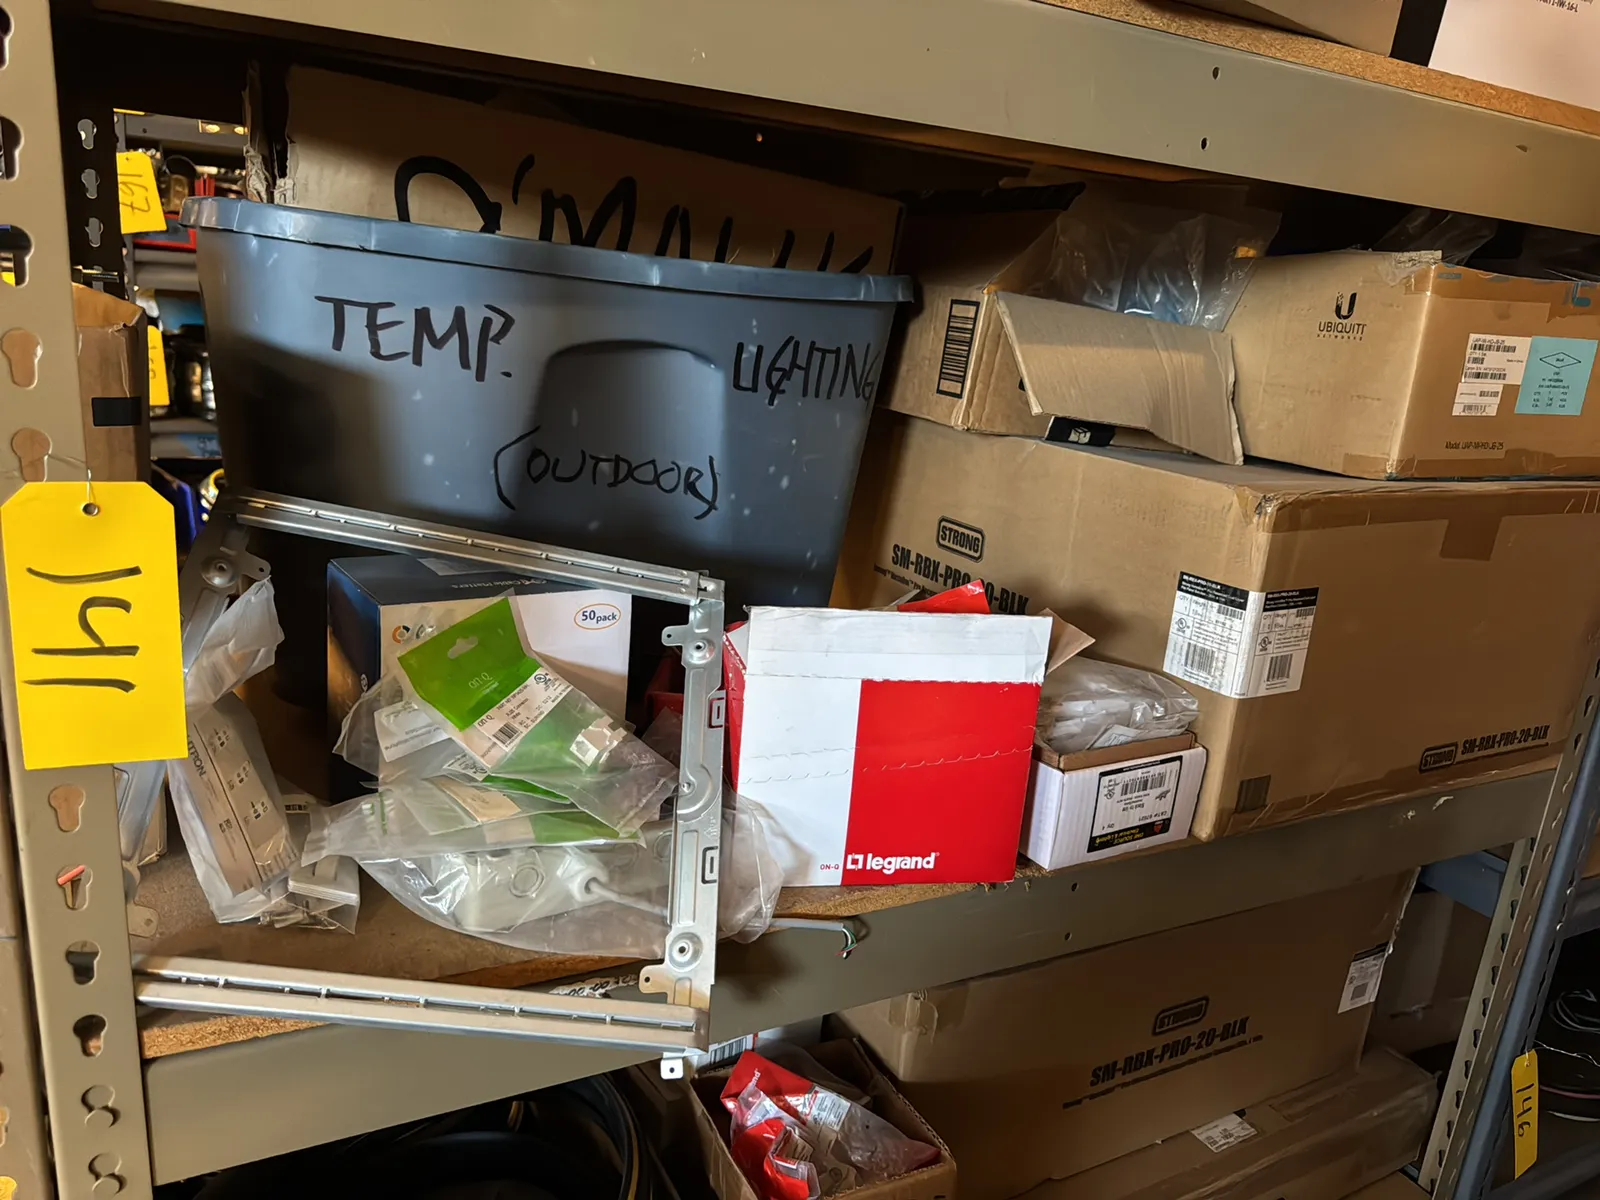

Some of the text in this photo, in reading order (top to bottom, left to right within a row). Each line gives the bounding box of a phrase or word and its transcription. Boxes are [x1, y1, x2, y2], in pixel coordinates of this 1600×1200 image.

[314, 295, 516, 383] TEMP.
[732, 335, 881, 409] LIGHTING
[940, 525, 980, 554] STRONG
[891, 543, 1029, 615] SM-RBX-PRO0-BLK
[866, 852, 936, 875] legrand
[1515, 1082, 1535, 1138] 146
